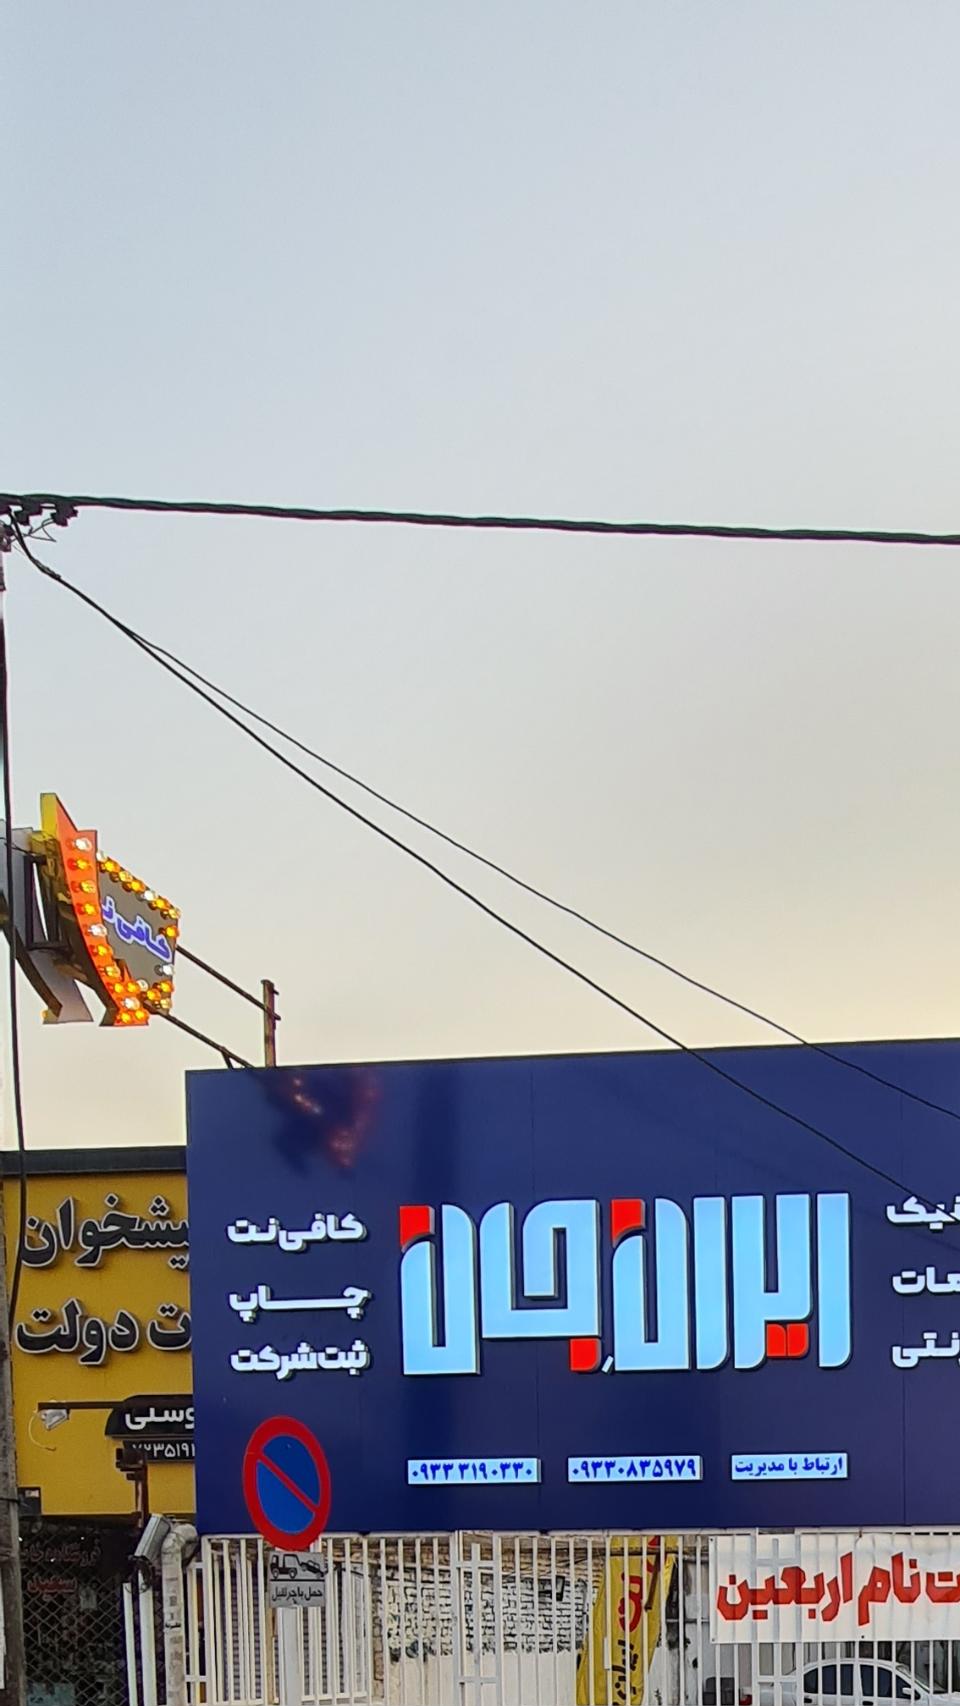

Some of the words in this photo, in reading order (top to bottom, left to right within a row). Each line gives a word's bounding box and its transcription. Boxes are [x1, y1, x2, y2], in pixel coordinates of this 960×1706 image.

[228, 1284, 372, 1323] چاپ
[16, 1299, 139, 1365] دولت
[735, 1458, 785, 1477] مدیریت
[788, 1457, 798, 1472] با
[803, 1457, 843, 1476] ارتباط
[716, 1551, 853, 1622] اربعین
[857, 1551, 922, 1626] نام
